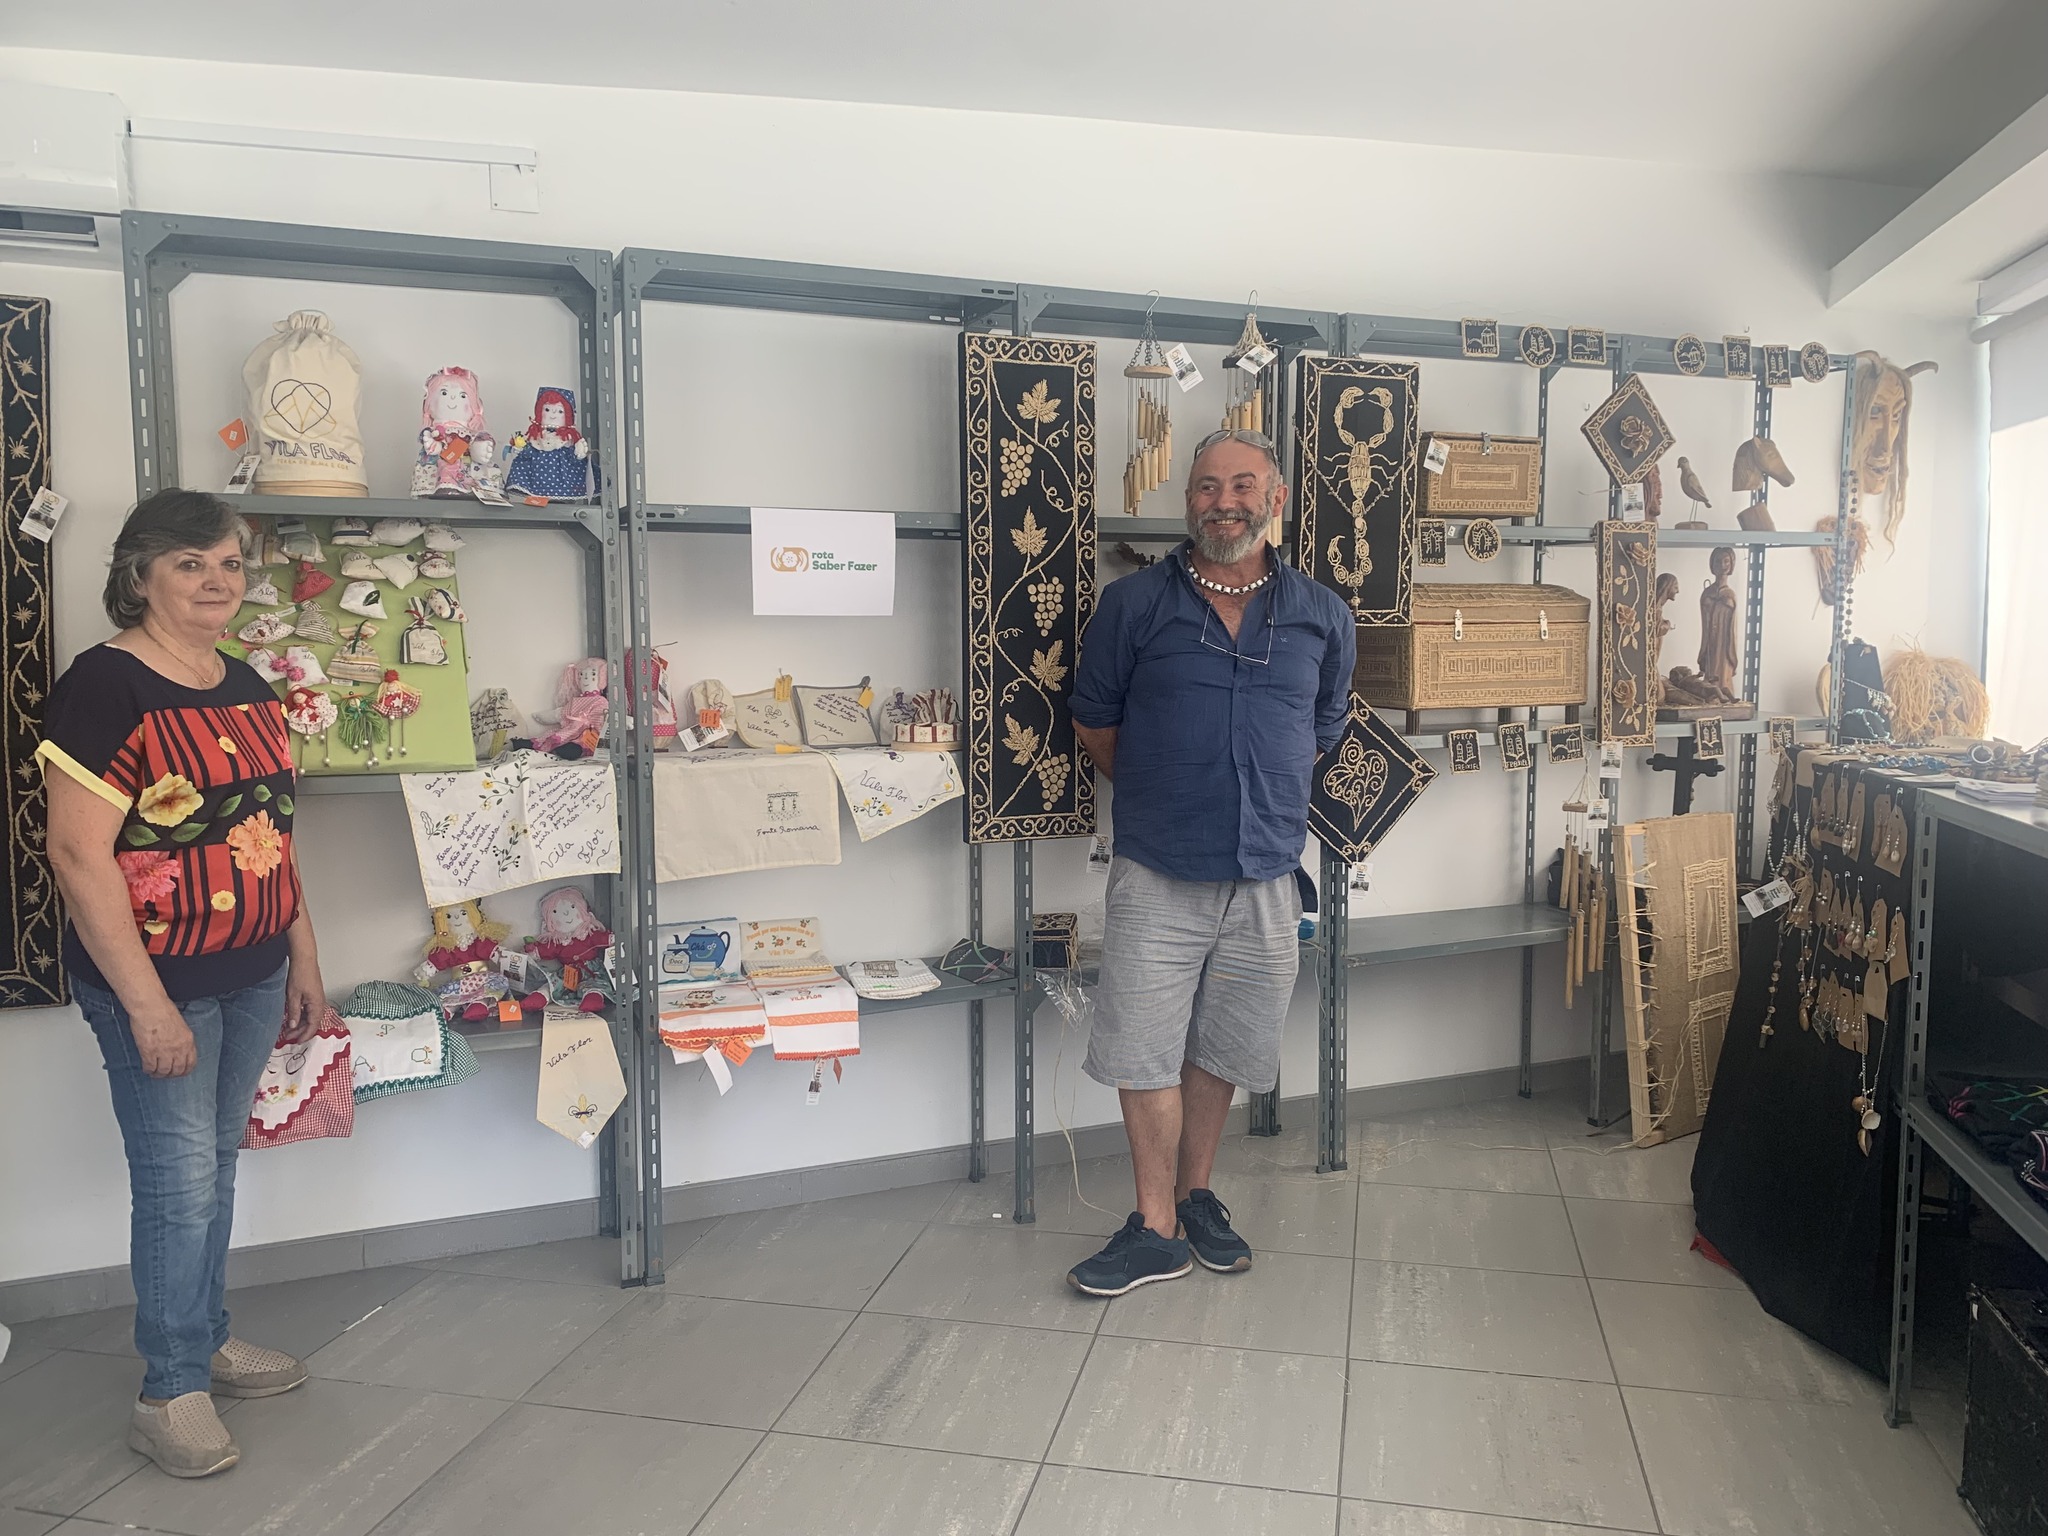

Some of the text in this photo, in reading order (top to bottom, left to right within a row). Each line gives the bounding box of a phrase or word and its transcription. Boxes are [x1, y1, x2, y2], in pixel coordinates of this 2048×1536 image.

[811, 551, 834, 560] rota
[812, 560, 878, 571] Saber Fazer
[860, 770, 908, 802] Vila Flor
[540, 829, 604, 868] Vila Flor
[690, 941, 705, 951] Chá
[546, 1037, 593, 1068] Vila Flor
